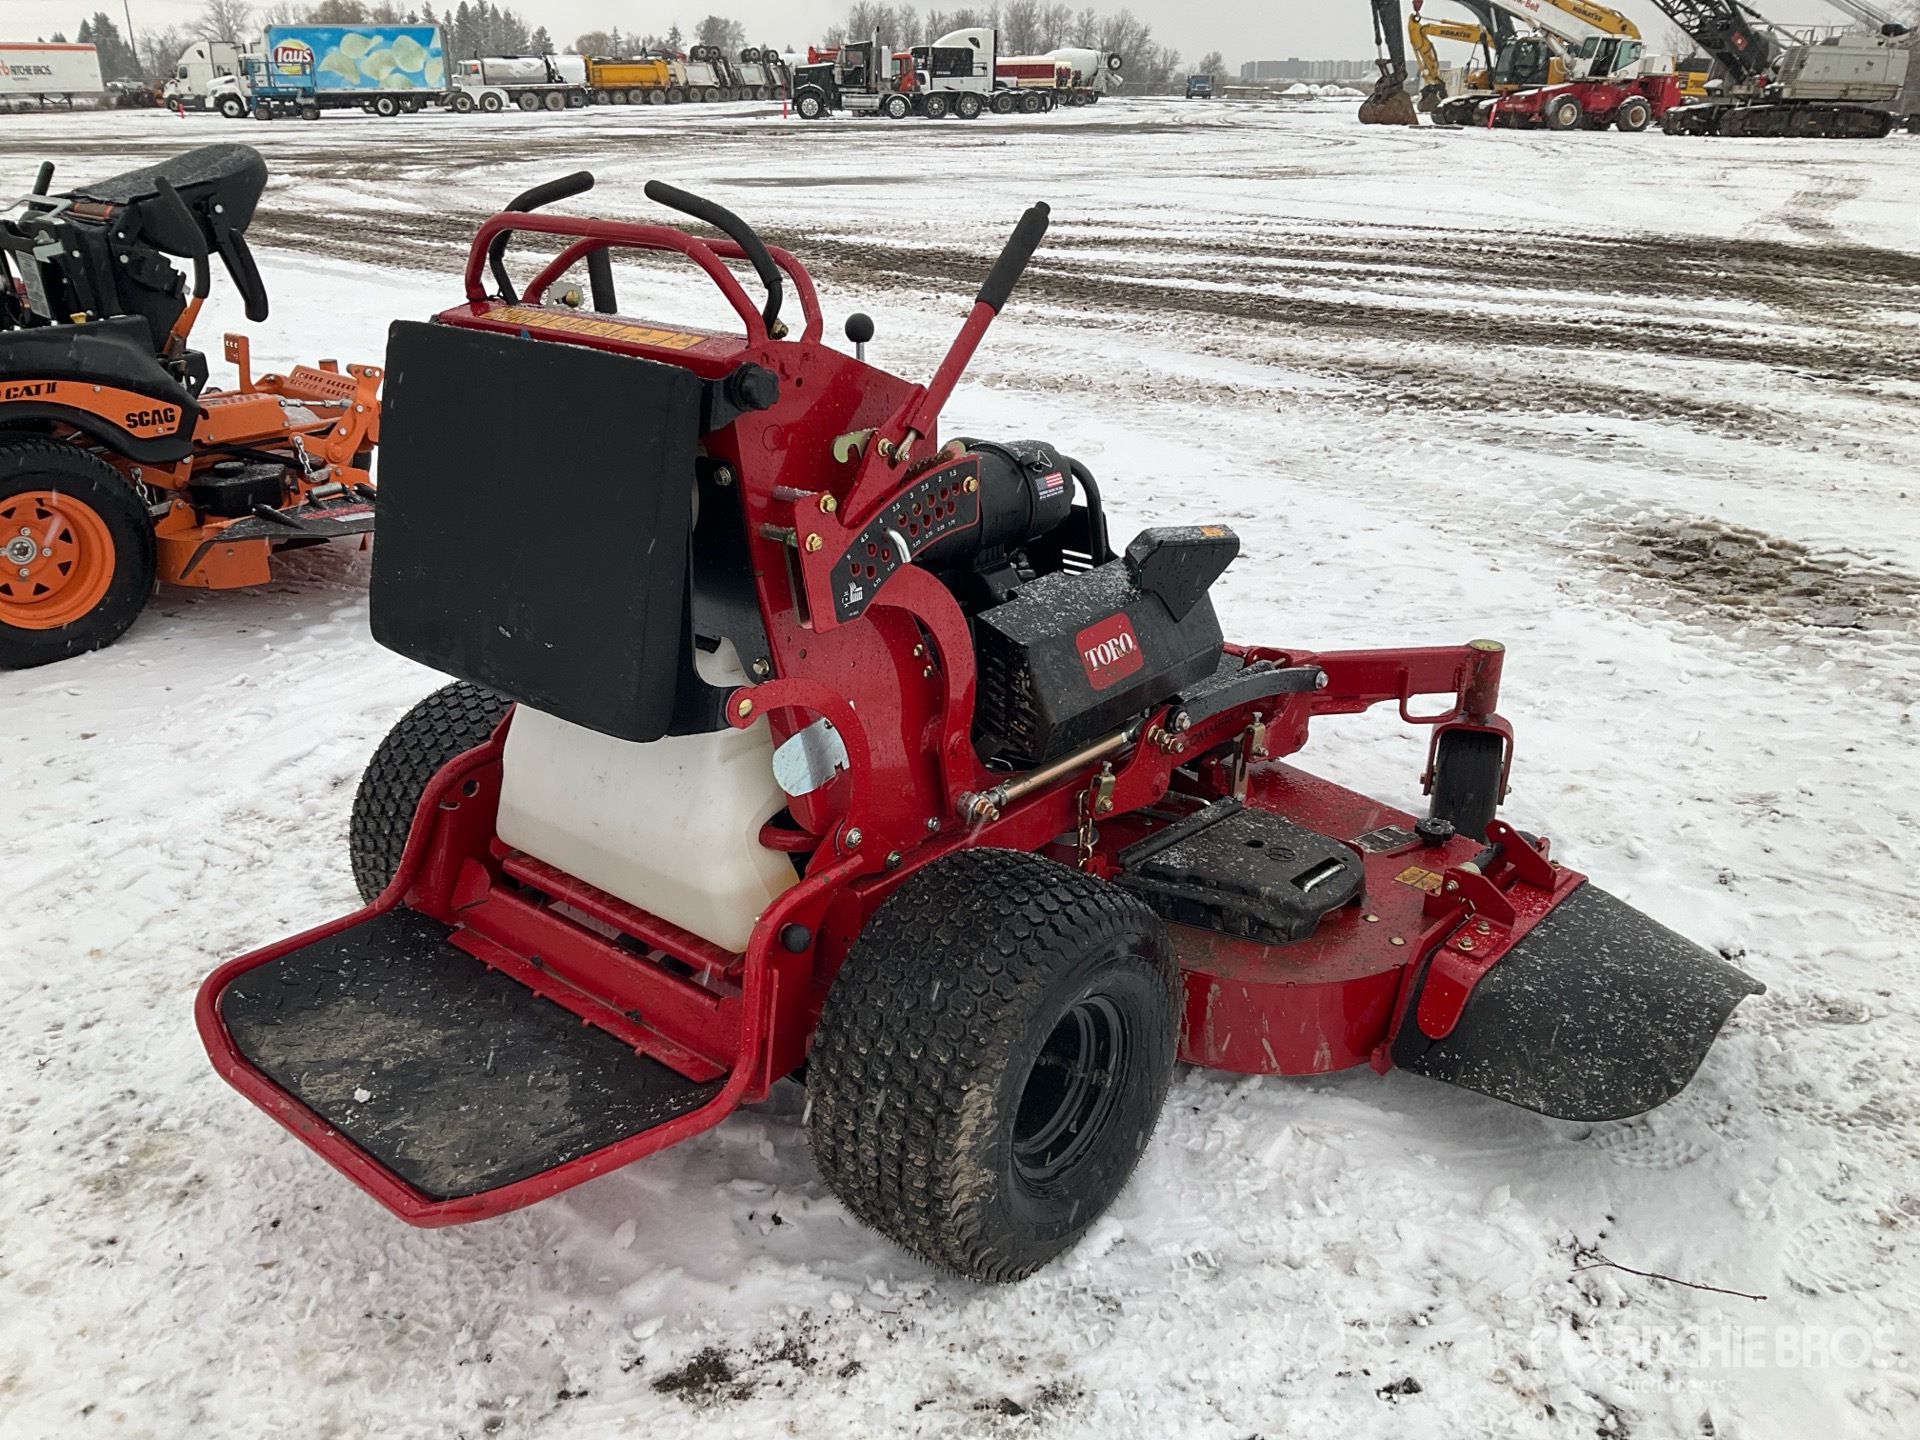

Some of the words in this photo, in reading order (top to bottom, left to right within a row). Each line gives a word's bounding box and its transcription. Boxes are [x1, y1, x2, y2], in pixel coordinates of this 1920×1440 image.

[1572, 5, 1604, 22] KOMATSU
[1439, 29, 1472, 39] KOMATSU
[5, 384, 45, 399] CAT
[125, 407, 175, 429] SCAG
[860, 533, 869, 543] 4.5
[921, 482, 930, 492] 2.5
[949, 469, 957, 477] 1.5
[1084, 632, 1133, 672] TORO
